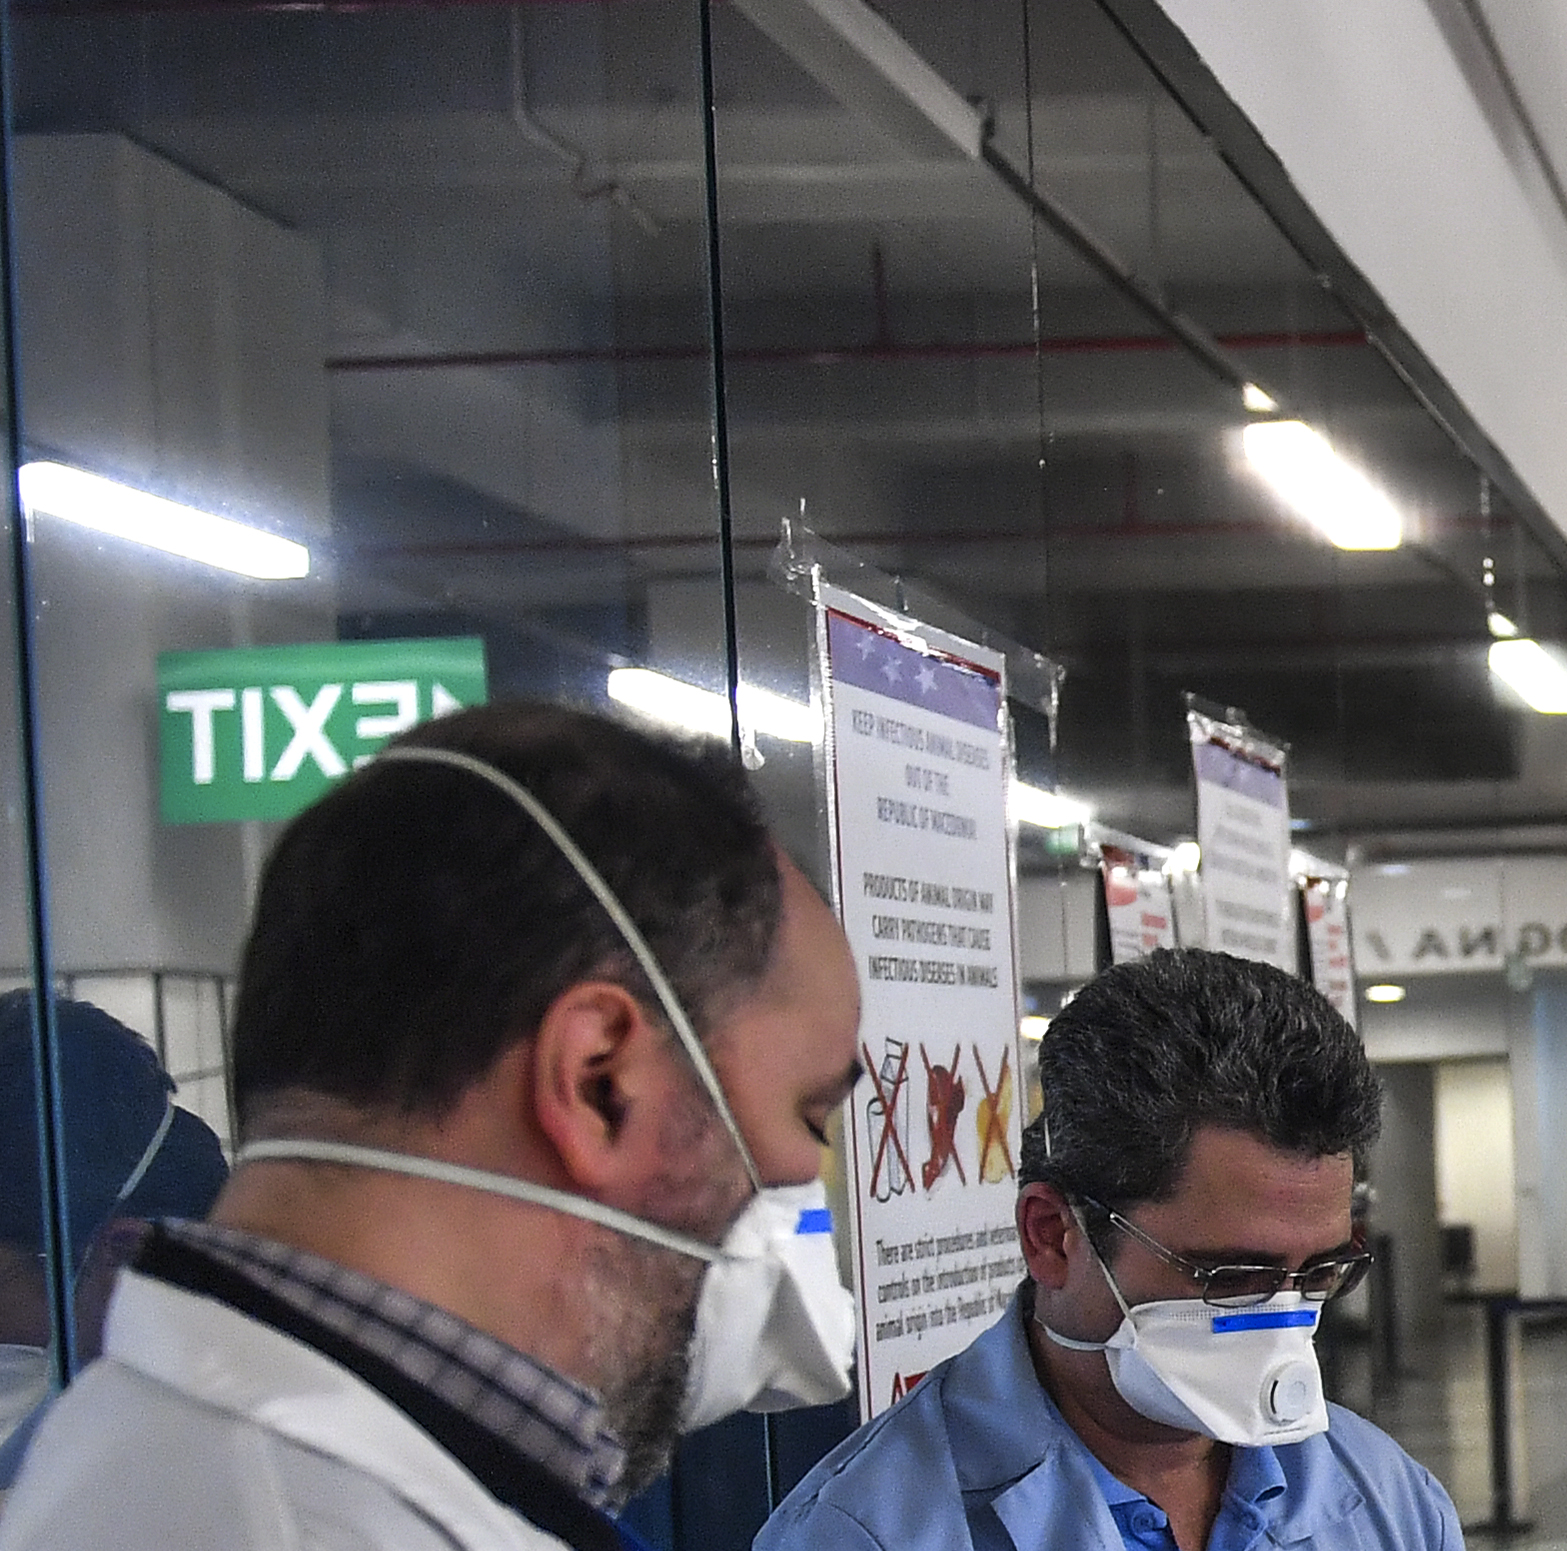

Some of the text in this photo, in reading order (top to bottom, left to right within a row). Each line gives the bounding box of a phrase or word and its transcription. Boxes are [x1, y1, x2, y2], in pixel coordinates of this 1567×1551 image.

[863, 871, 907, 902] PRODUCTS
[908, 879, 919, 902] OF
[920, 881, 951, 908] ANIMAL
[872, 914, 900, 941] CARRY
[869, 955, 918, 983] INFECTIOUS
[919, 958, 955, 985] DISEASES
